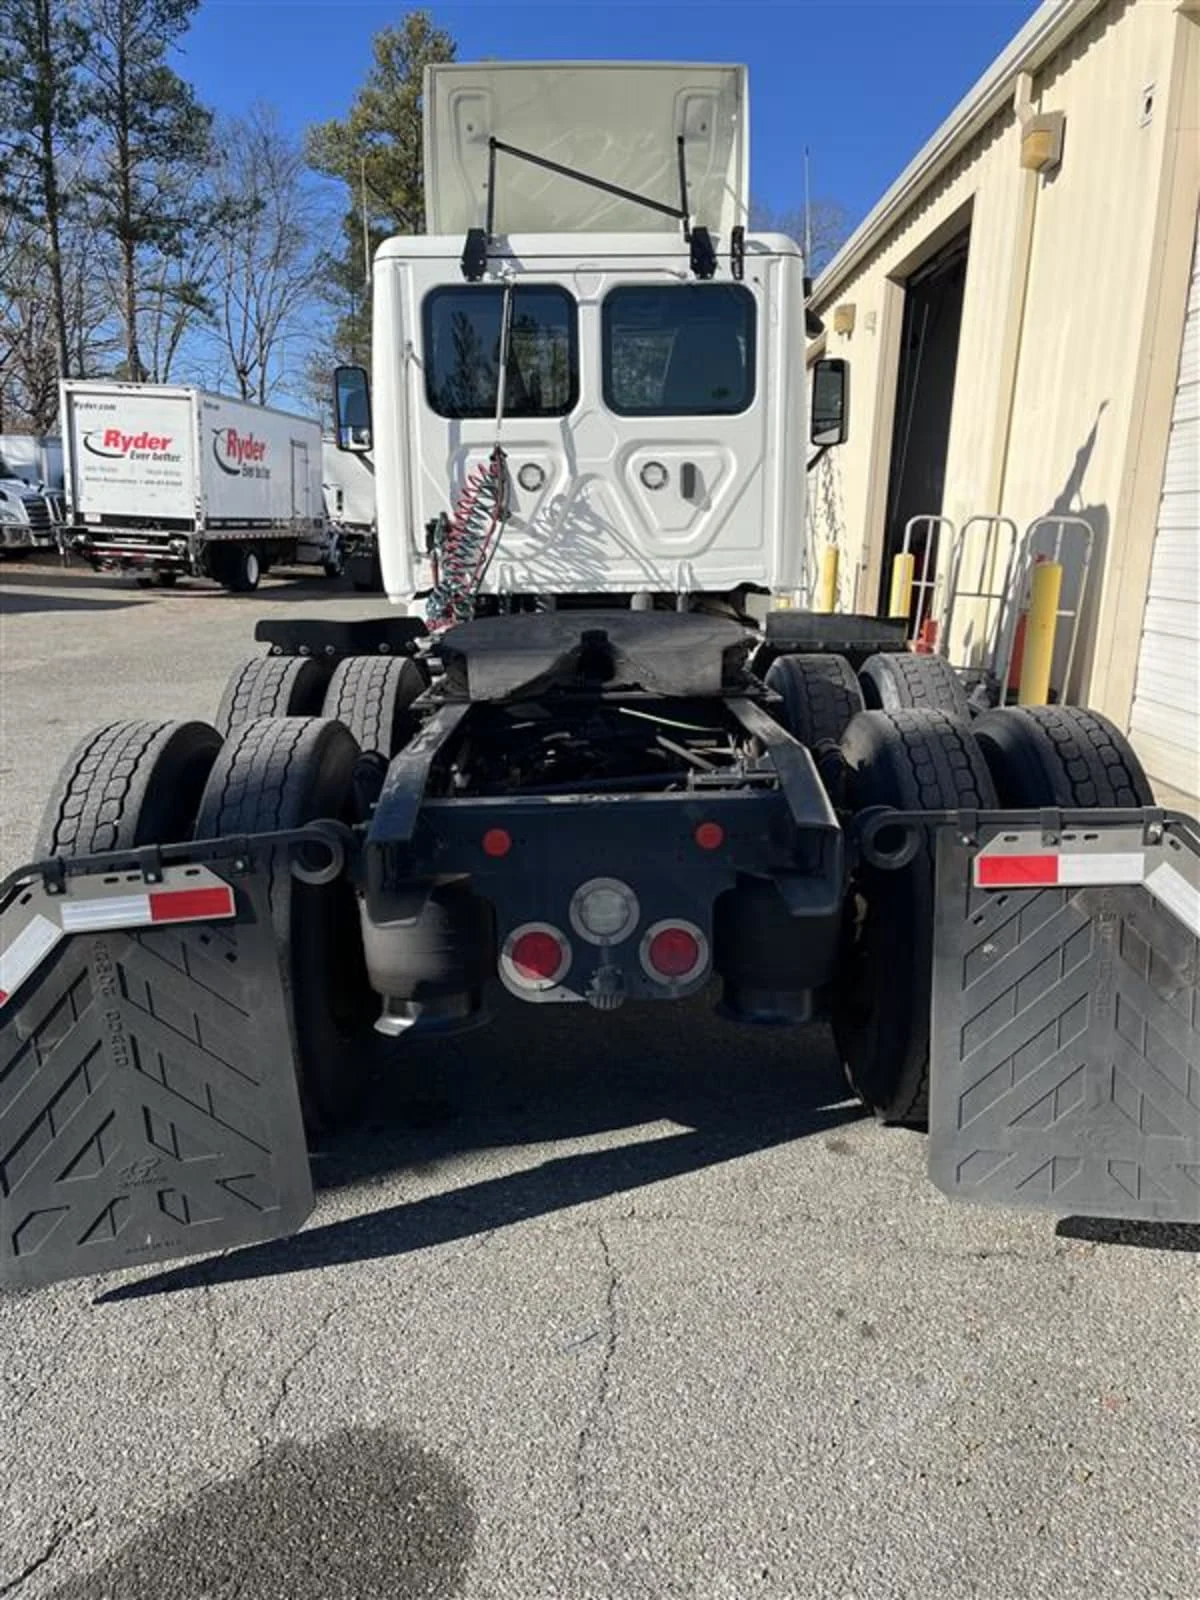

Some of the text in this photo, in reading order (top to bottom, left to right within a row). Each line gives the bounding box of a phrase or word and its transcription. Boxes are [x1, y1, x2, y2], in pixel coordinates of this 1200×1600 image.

[103, 429, 172, 452] Ryder
[227, 429, 266, 465] Ryder
[130, 450, 151, 460] Ever
